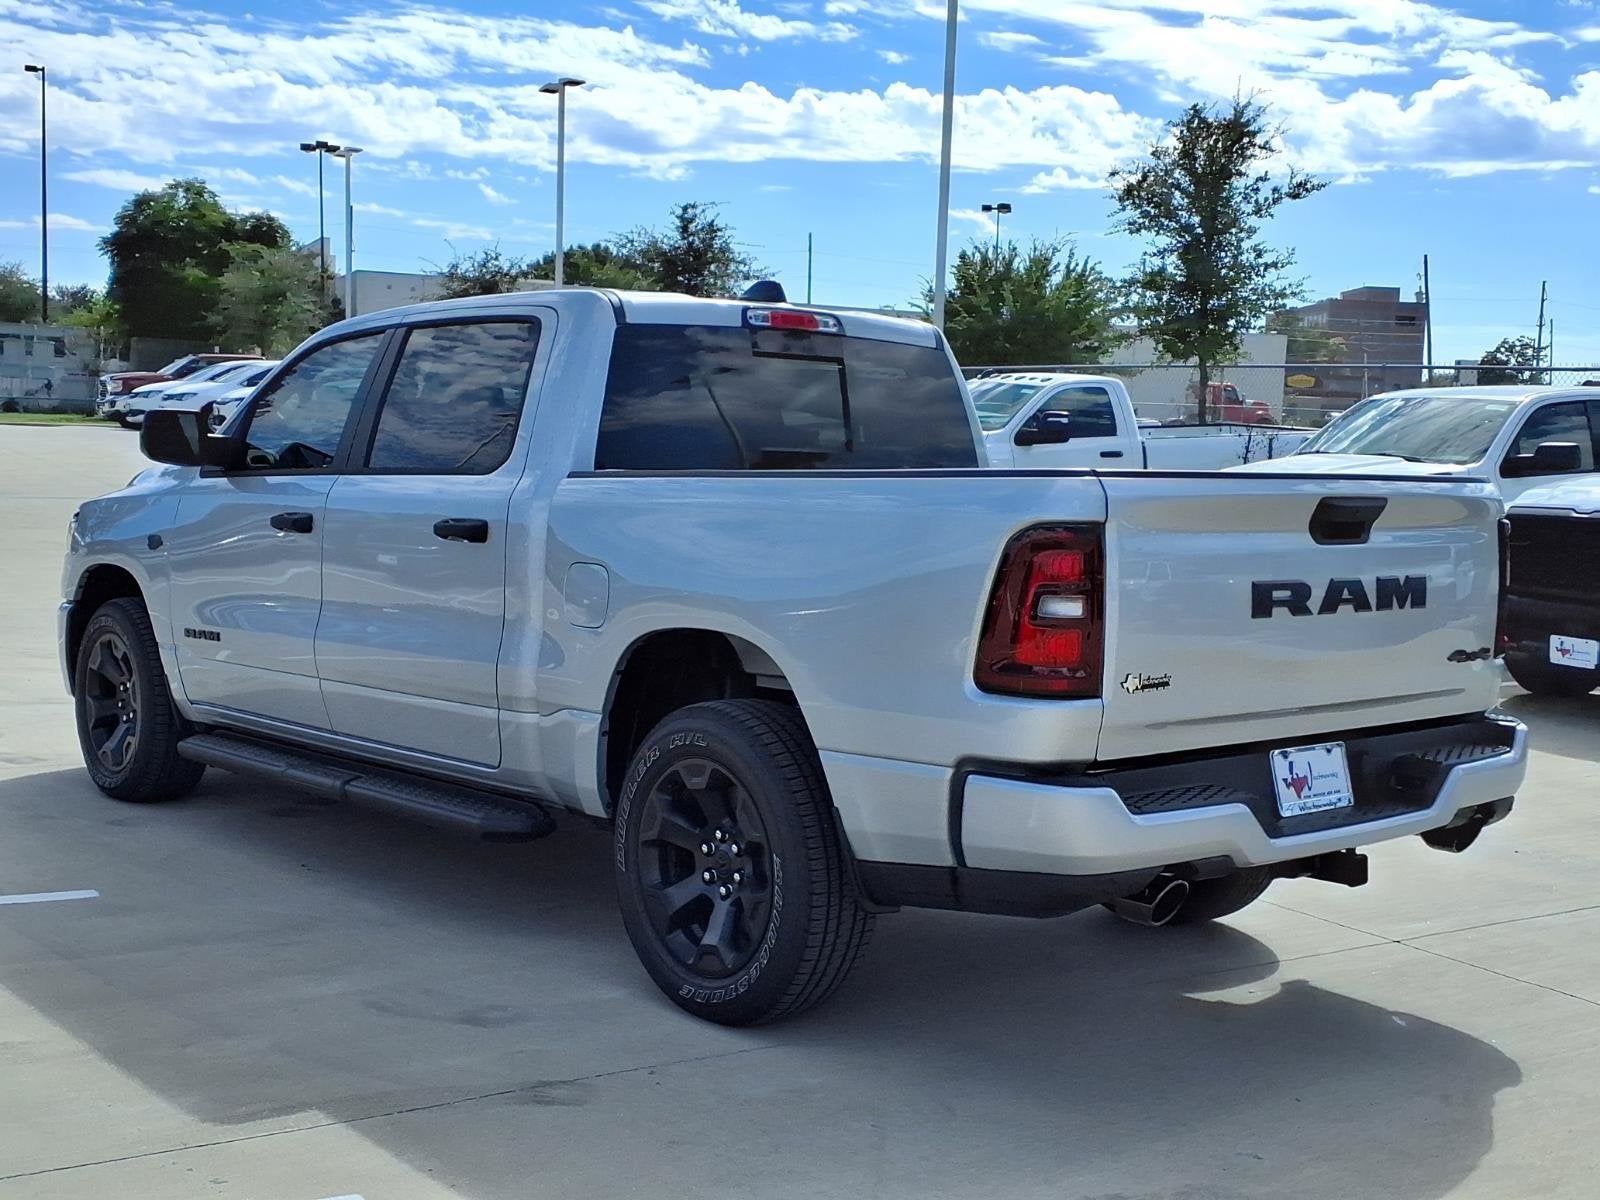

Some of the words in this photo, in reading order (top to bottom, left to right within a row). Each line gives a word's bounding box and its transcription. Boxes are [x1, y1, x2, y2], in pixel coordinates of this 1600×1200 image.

[1251, 575, 1427, 619] RAM
[616, 746, 660, 872] DUELER
[678, 853, 784, 1003] BRIDGESTONE
